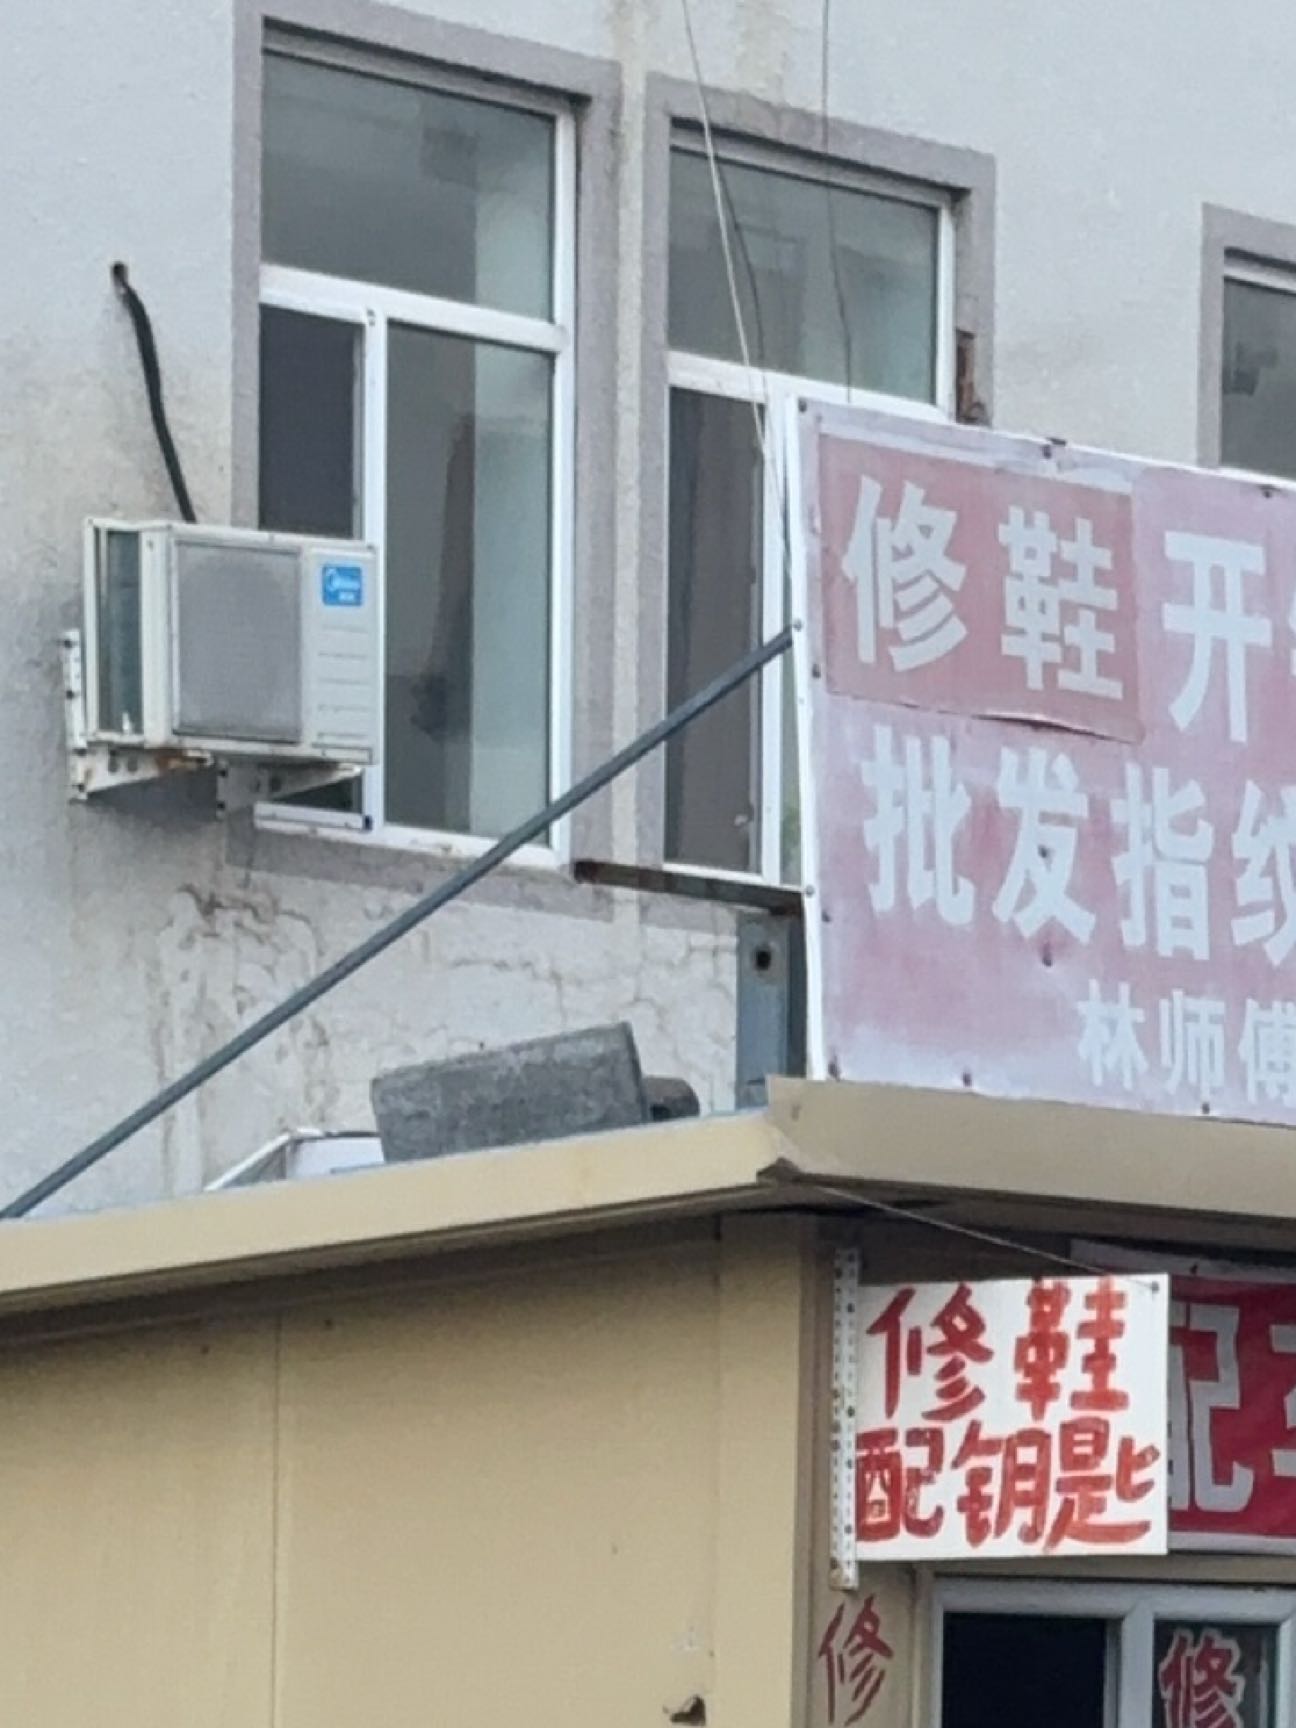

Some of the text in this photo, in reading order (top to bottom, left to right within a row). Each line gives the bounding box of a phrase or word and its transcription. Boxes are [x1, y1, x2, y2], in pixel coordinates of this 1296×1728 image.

[842, 475, 1124, 701] 修鞋
[866, 1274, 1130, 1421] 修鞋
[856, 1416, 1160, 1553] 配钥匙
